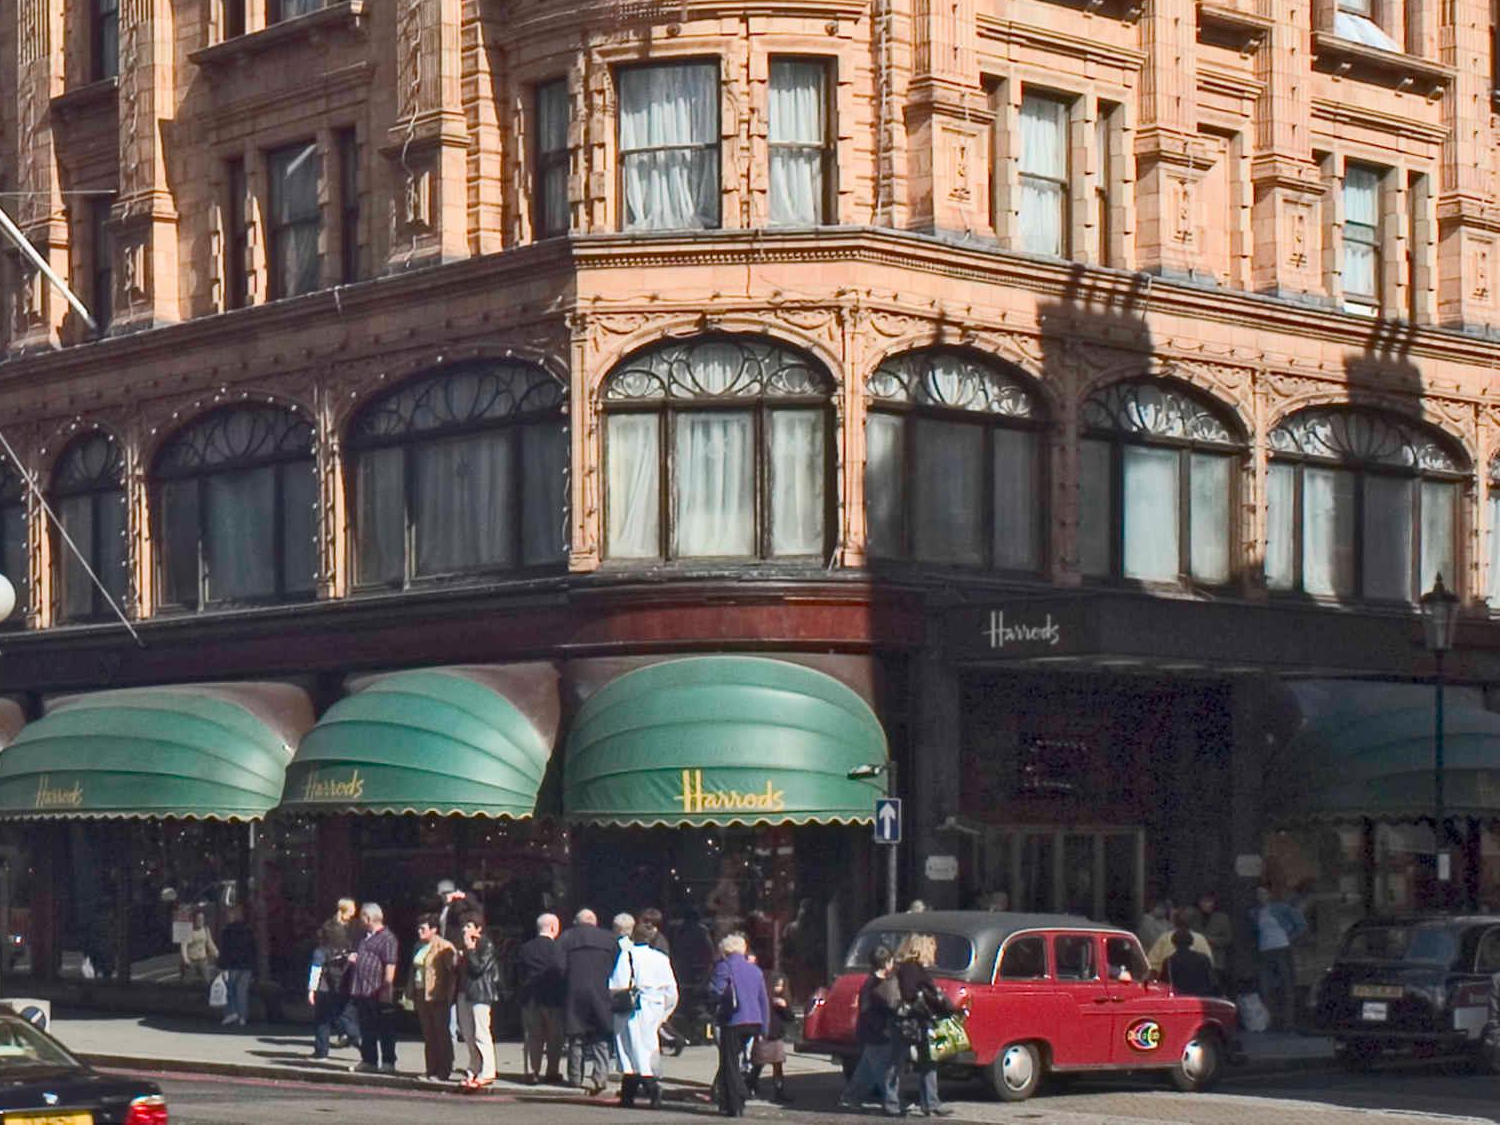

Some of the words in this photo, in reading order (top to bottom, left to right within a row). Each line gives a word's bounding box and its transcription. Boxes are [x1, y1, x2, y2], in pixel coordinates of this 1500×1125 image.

[981, 610, 1060, 648] Harrods
[35, 774, 84, 809] Harrods
[301, 768, 364, 802] Harrods
[674, 770, 785, 812] Harrods
